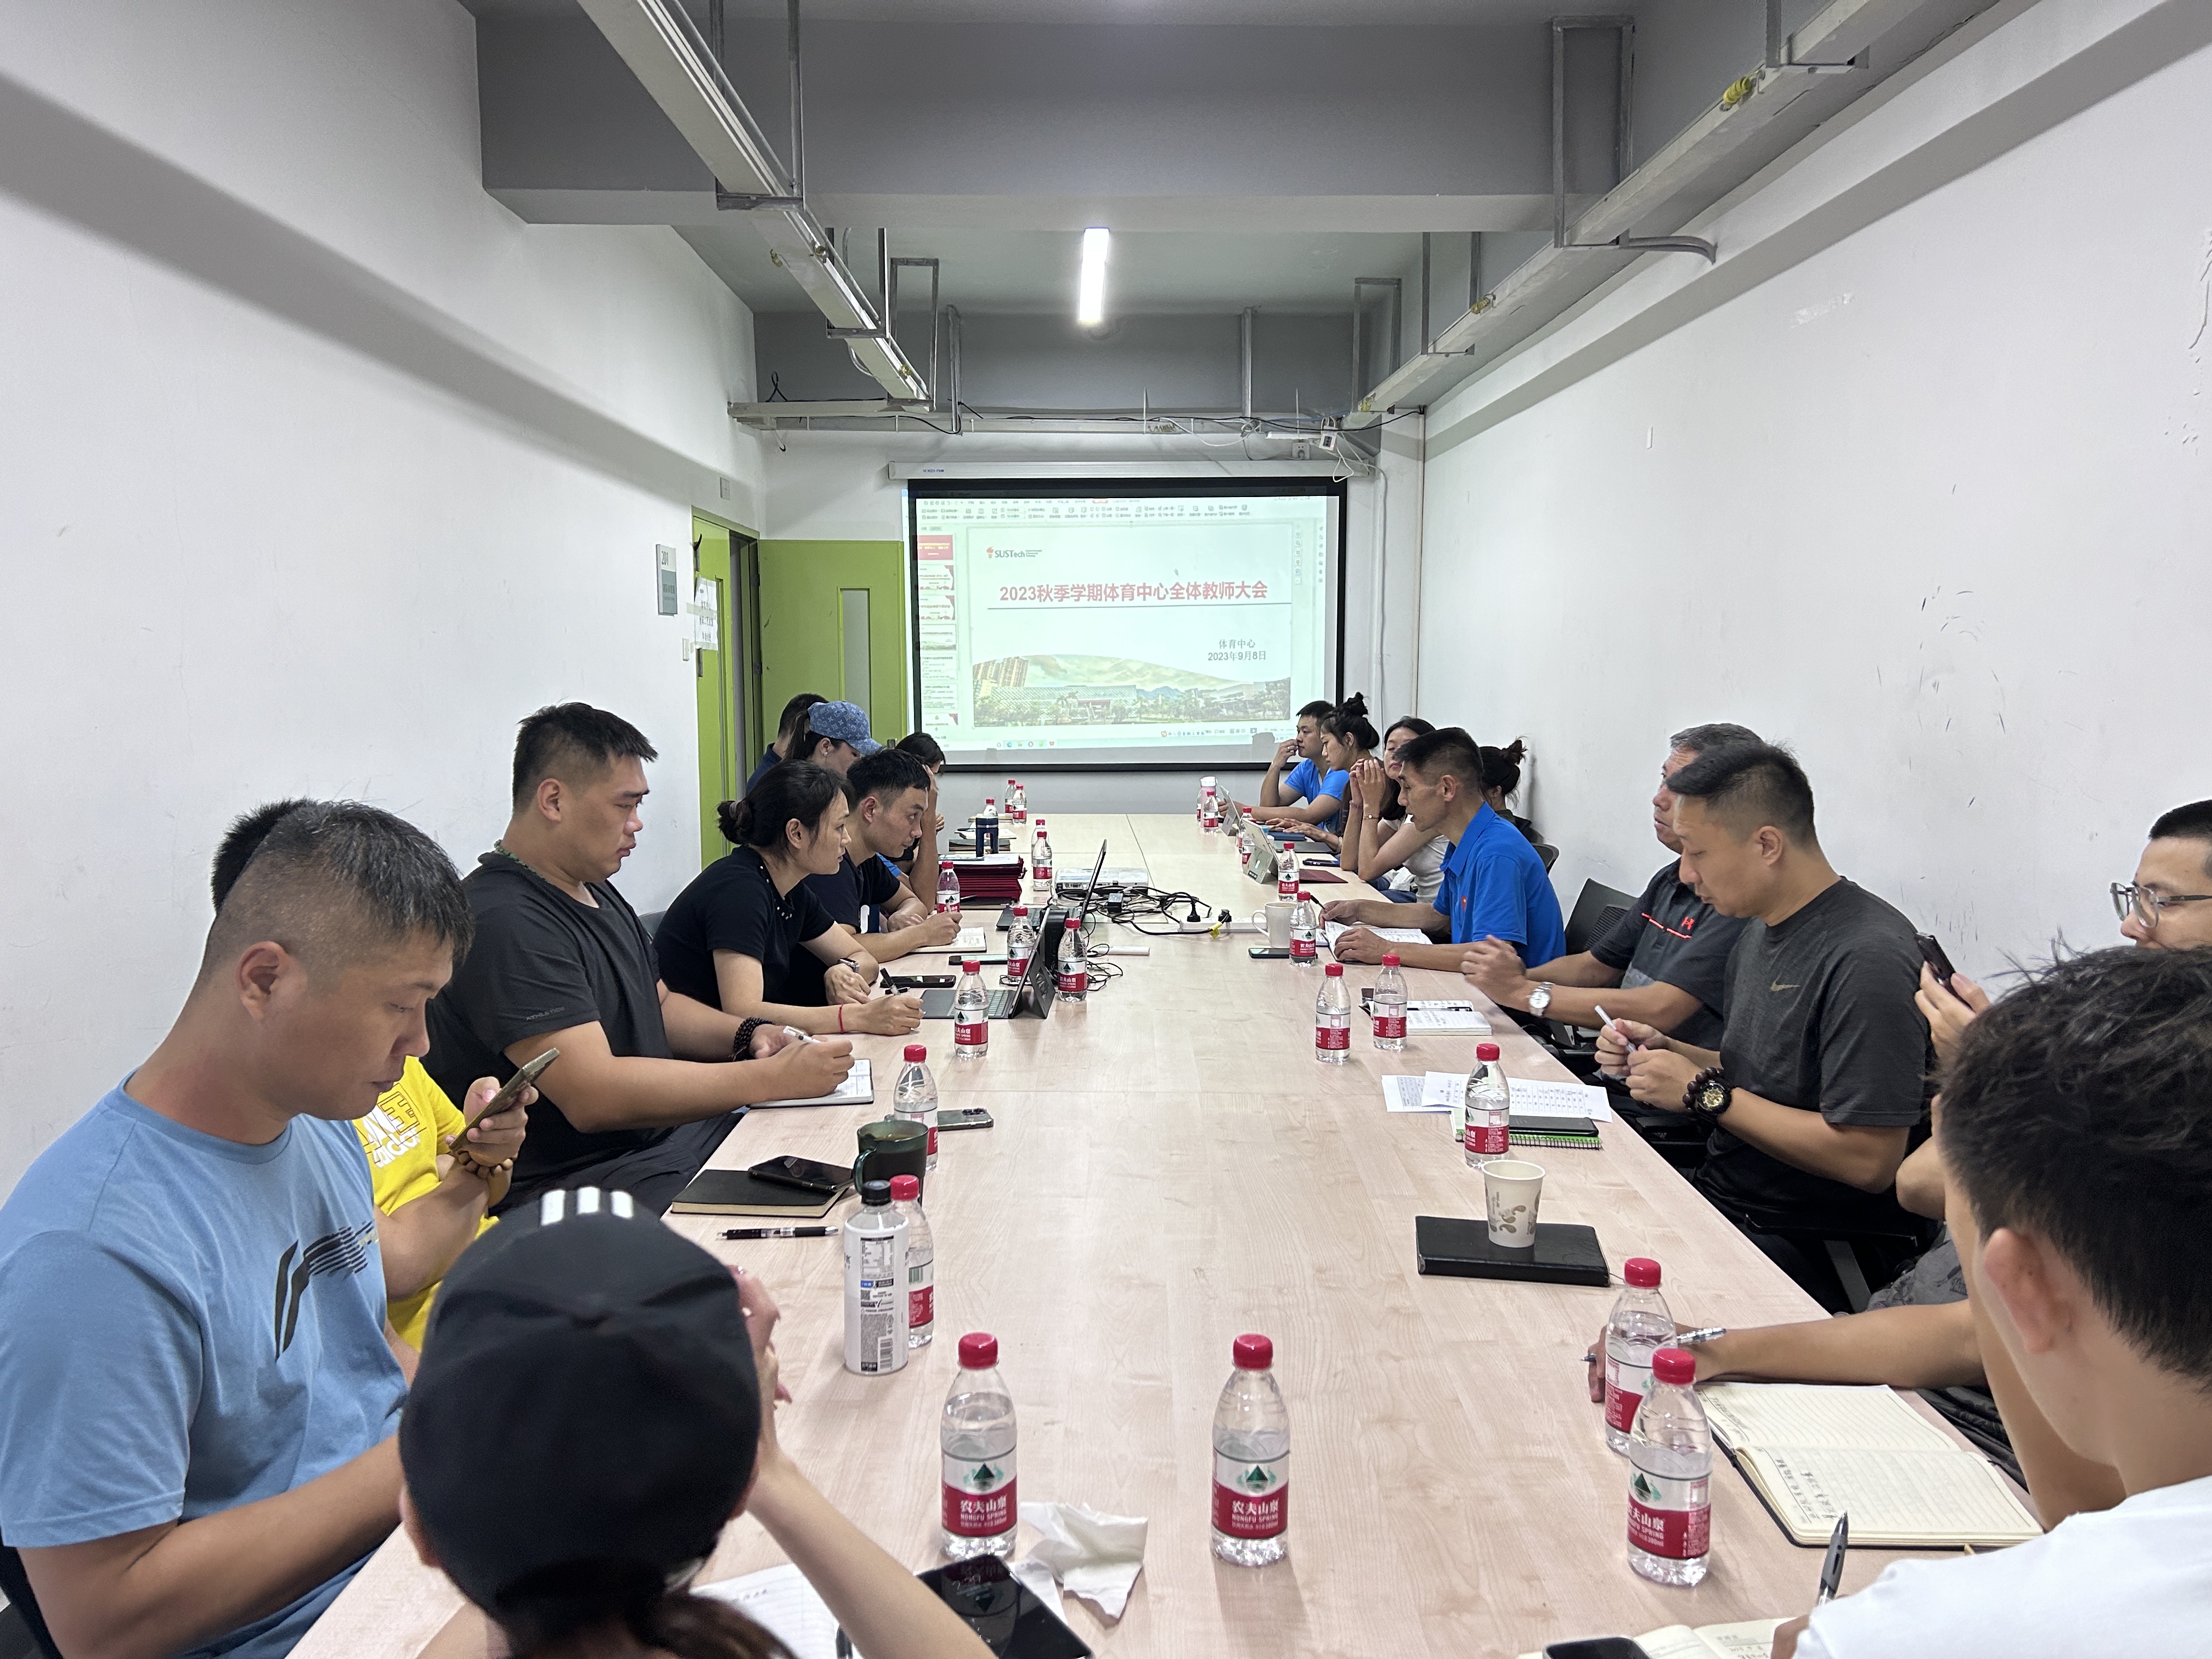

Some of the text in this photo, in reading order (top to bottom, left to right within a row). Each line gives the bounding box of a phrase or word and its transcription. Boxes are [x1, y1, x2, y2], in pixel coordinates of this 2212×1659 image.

[994, 550, 1025, 558] SUSTech
[1000, 580, 1268, 602] 2023秋季学期体育中心全体教师大会
[1219, 639, 1255, 649] 体育中心
[1207, 651, 1266, 661] 2023年9月8日
[960, 1494, 1007, 1514] 农夫山泉
[1232, 1498, 1279, 1515] 农夫山泉
[1232, 1513, 1256, 1523] NONGFU
